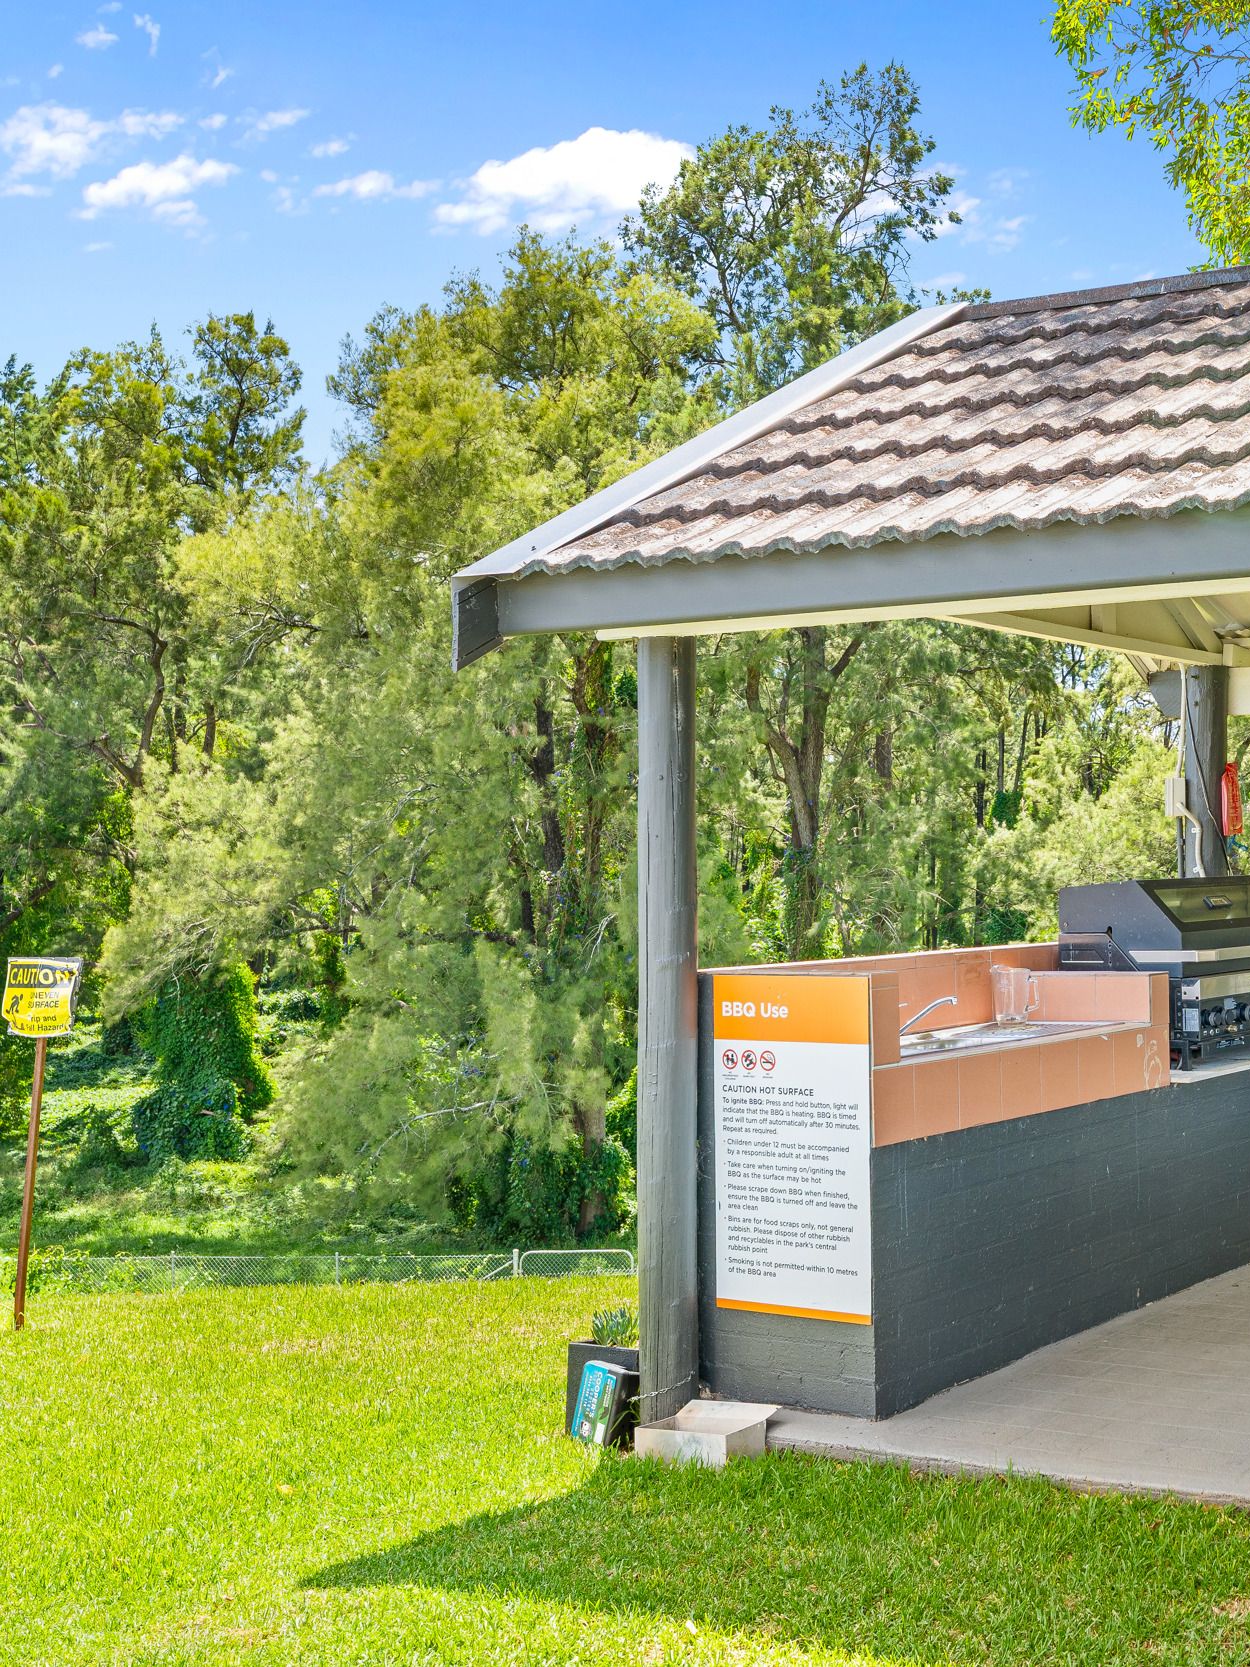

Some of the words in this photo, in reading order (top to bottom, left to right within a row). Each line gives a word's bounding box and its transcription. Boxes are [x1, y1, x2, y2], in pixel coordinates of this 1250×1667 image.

[10, 968, 70, 984] CAUTION
[722, 1001, 756, 1017] BBQ
[760, 1002, 789, 1018] Use
[28, 1014, 40, 1023] rip
[722, 1084, 756, 1093] CAUTION
[778, 1087, 813, 1096] SURFACE
[768, 1119, 808, 1128] automatically
[798, 1166, 833, 1176] on/igniting
[823, 1190, 849, 1200] finished,
[753, 1226, 772, 1235] Please
[774, 1229, 798, 1237] dispose
[740, 1236, 774, 1244] recyclables
[728, 1256, 754, 1266] Smoking
